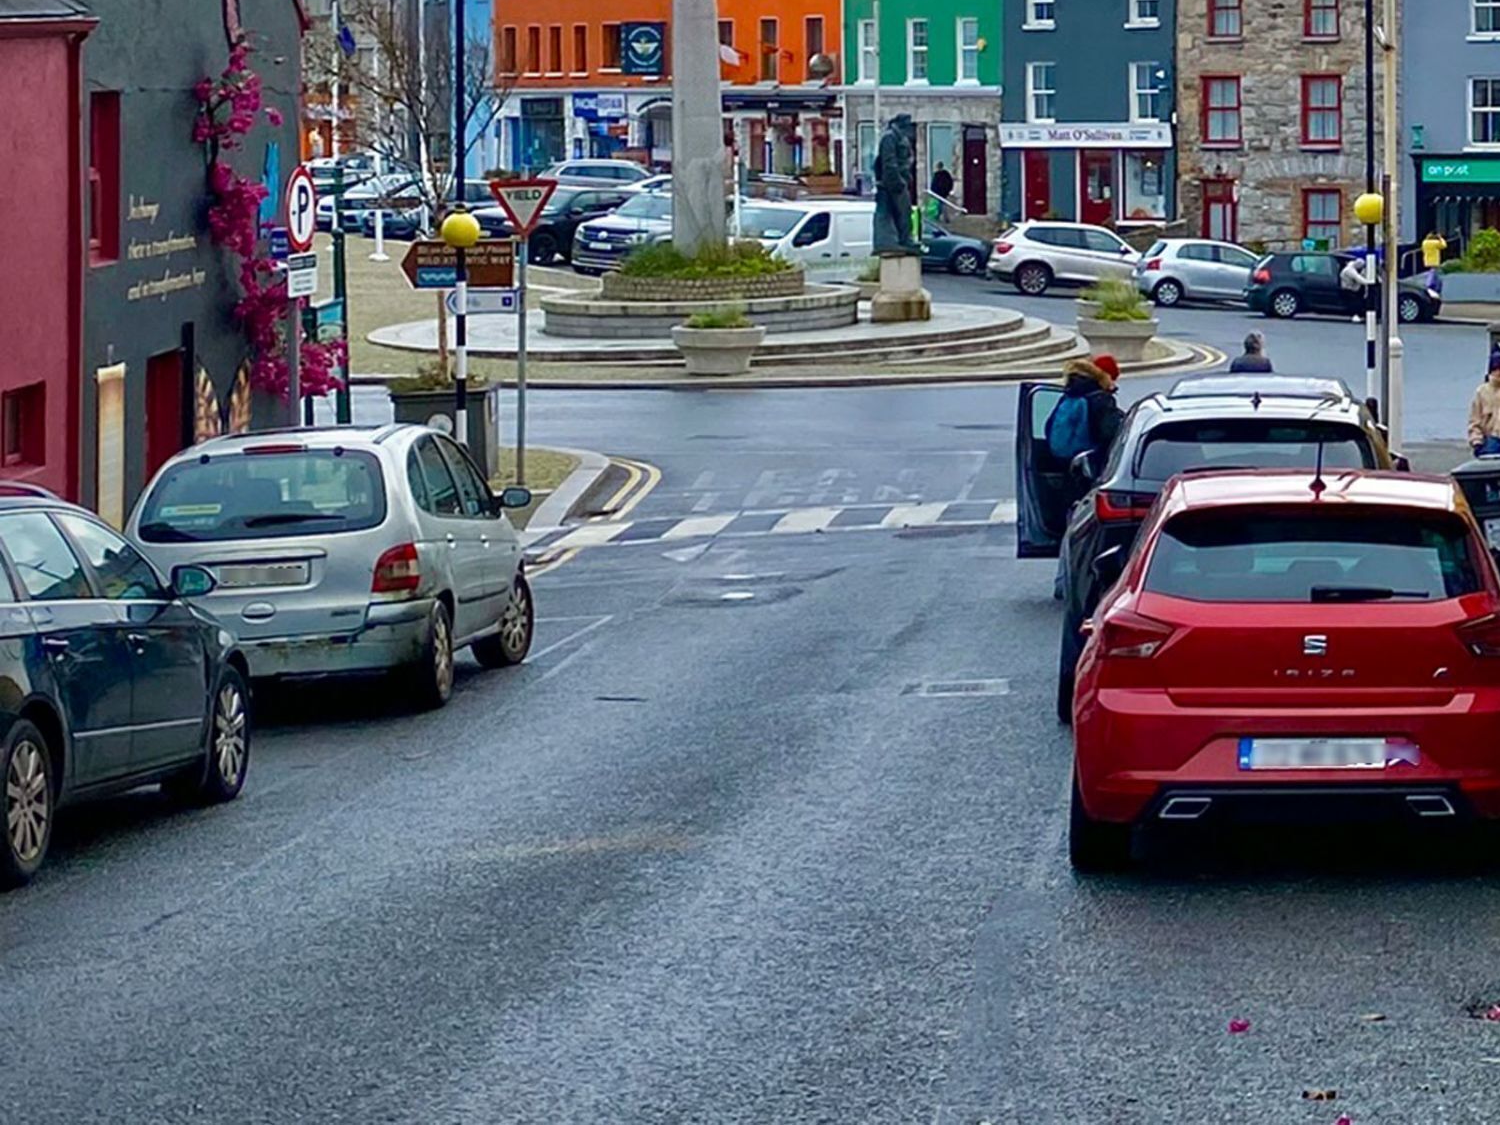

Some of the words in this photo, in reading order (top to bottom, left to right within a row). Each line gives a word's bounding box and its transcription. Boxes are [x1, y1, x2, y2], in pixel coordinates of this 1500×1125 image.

[1048, 129, 1070, 141] Matt
[1072, 129, 1123, 141] O'Sullivan
[504, 189, 542, 201] YIELD
[442, 256, 488, 265] ATNTIC
[490, 256, 511, 265] WAY
